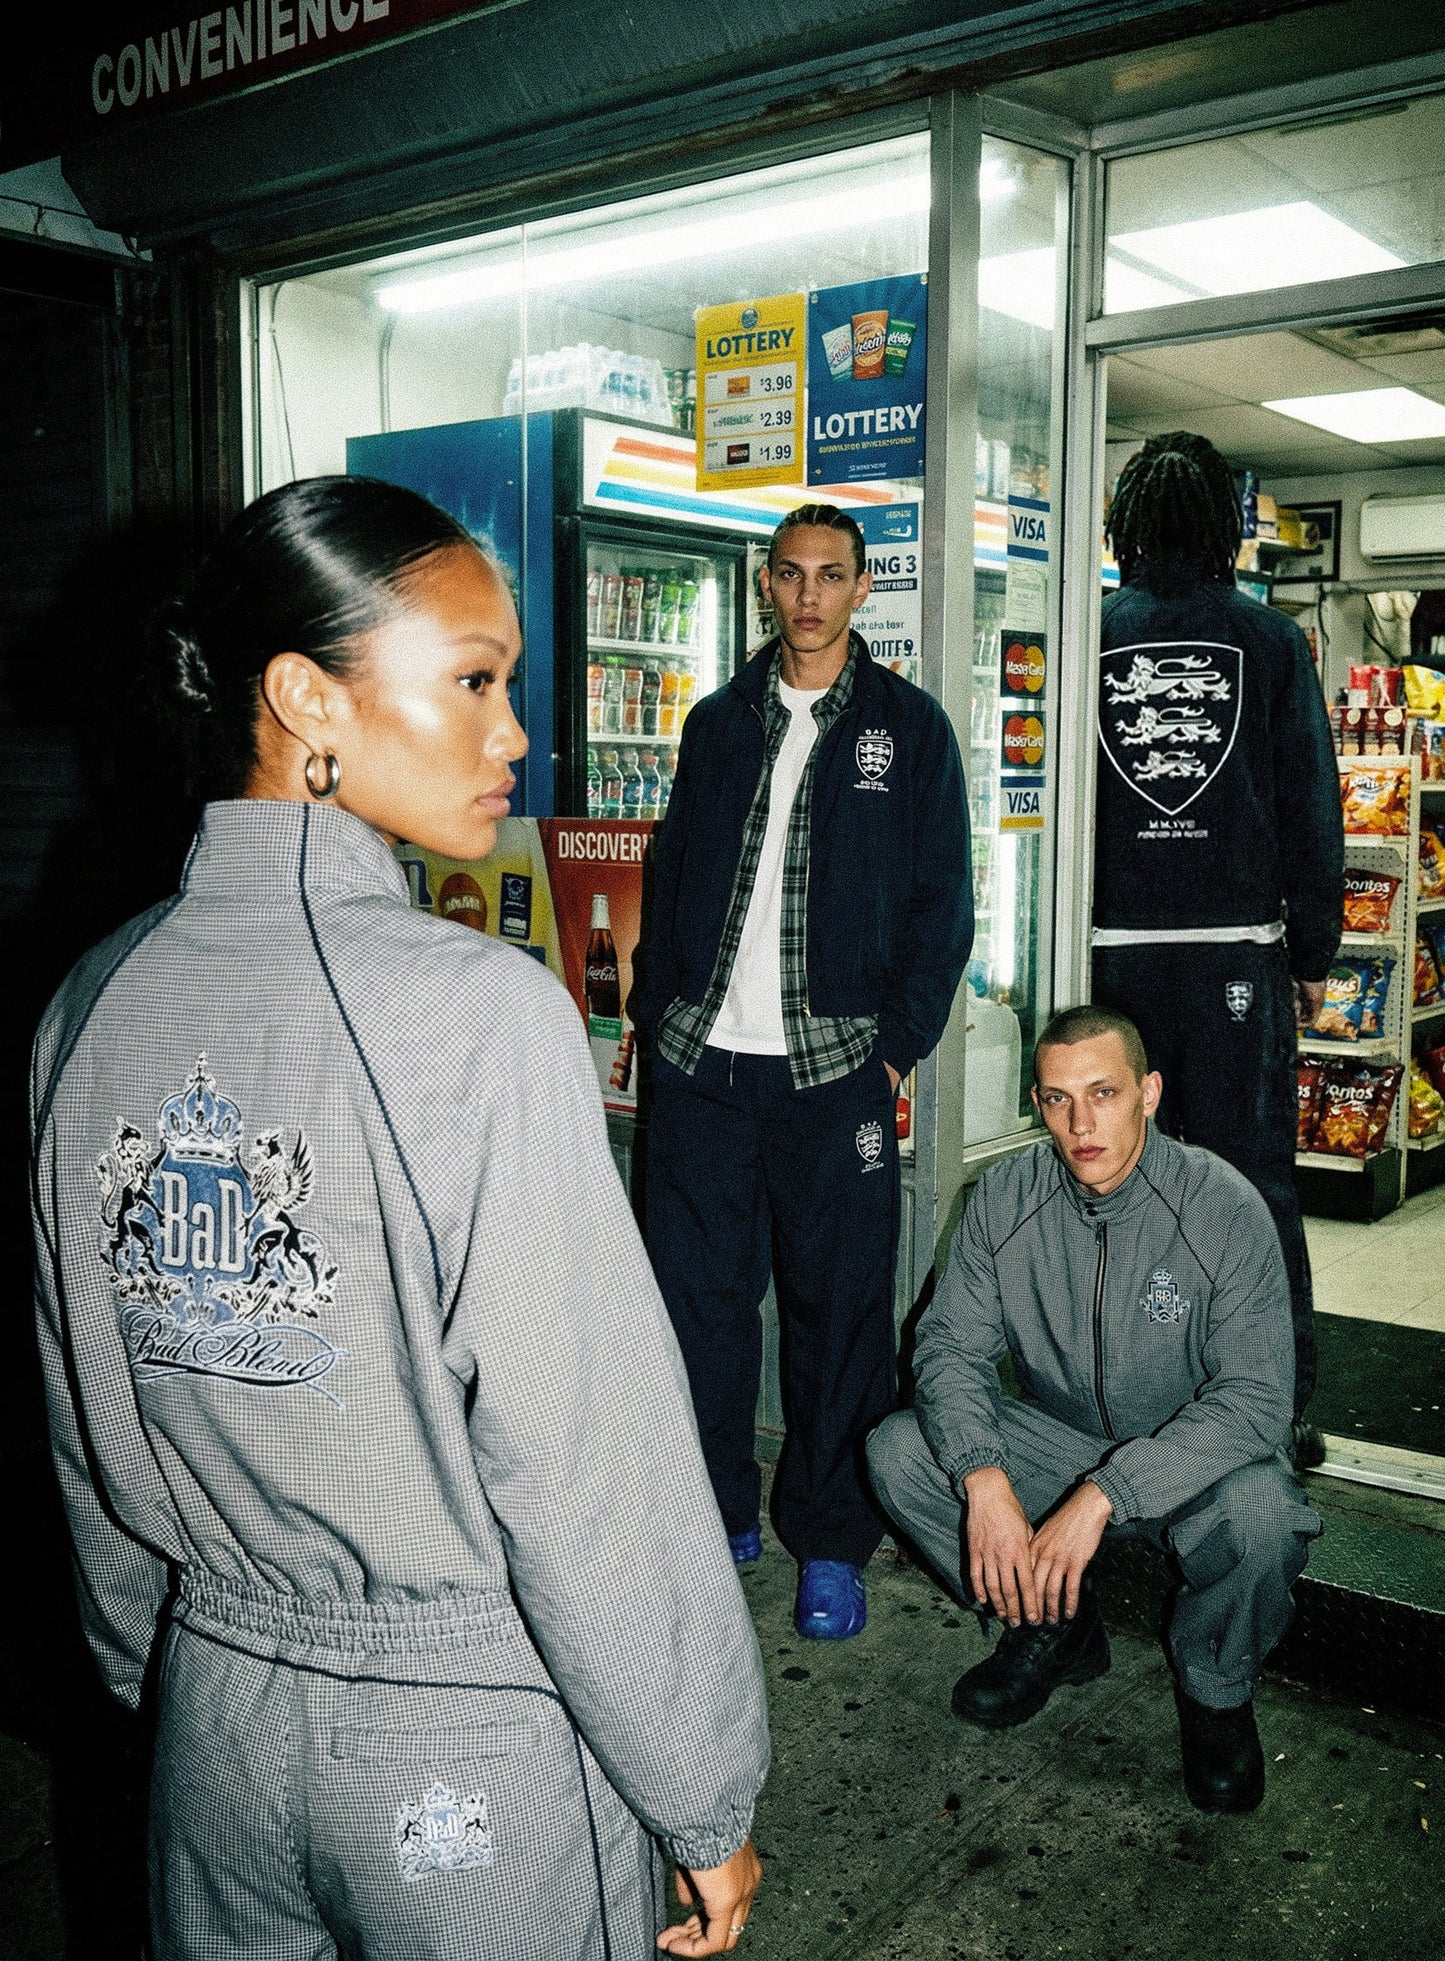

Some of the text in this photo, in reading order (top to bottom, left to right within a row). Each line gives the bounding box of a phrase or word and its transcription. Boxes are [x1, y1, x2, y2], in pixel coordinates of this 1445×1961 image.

[706, 327, 795, 359] LOTTERY
[814, 403, 923, 440] LOTTERY
[1011, 514, 1046, 542] VISA
[906, 555, 917, 573] 3
[1007, 791, 1040, 814] VISA
[160, 1170, 247, 1274] BaD
